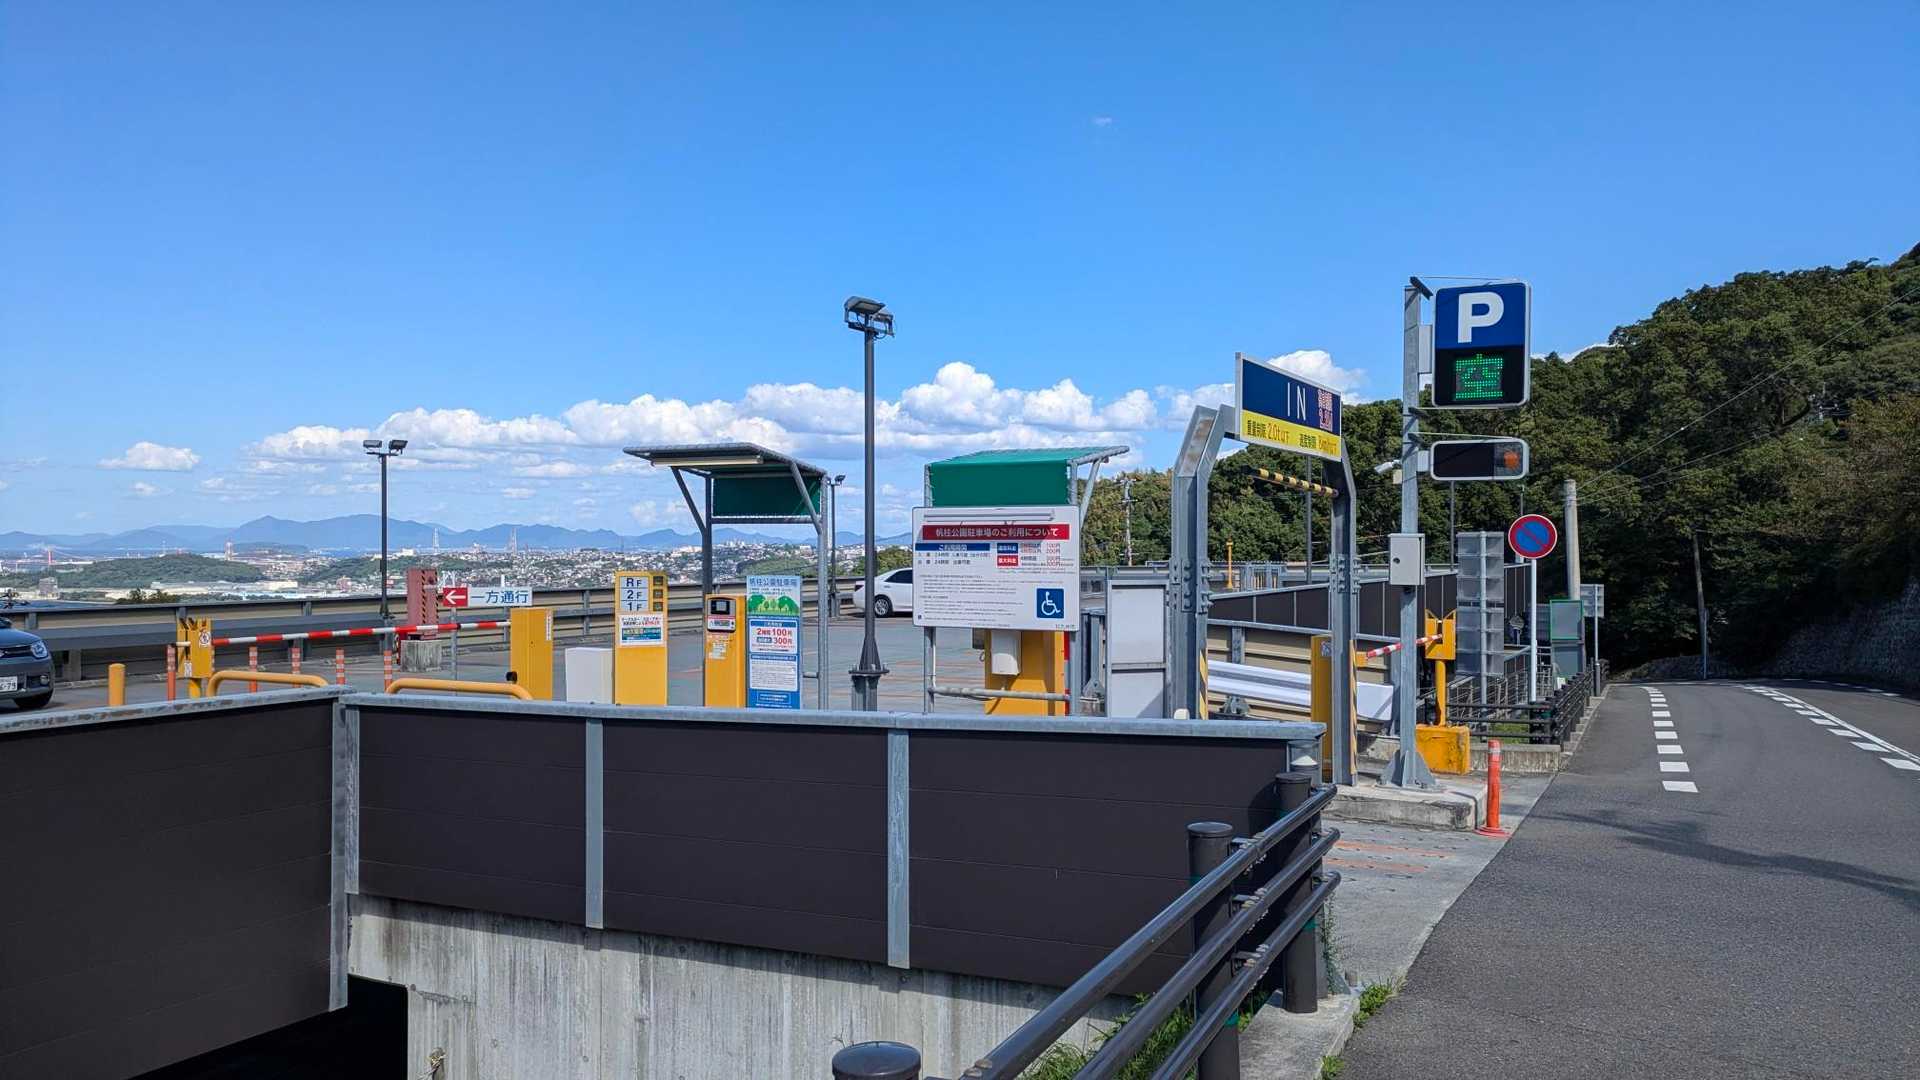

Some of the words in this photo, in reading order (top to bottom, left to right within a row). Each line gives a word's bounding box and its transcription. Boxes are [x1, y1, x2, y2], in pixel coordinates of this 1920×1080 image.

[1457, 291, 1505, 344] P
[1455, 353, 1503, 399] 空
[470, 590, 529, 604] 一方通行
